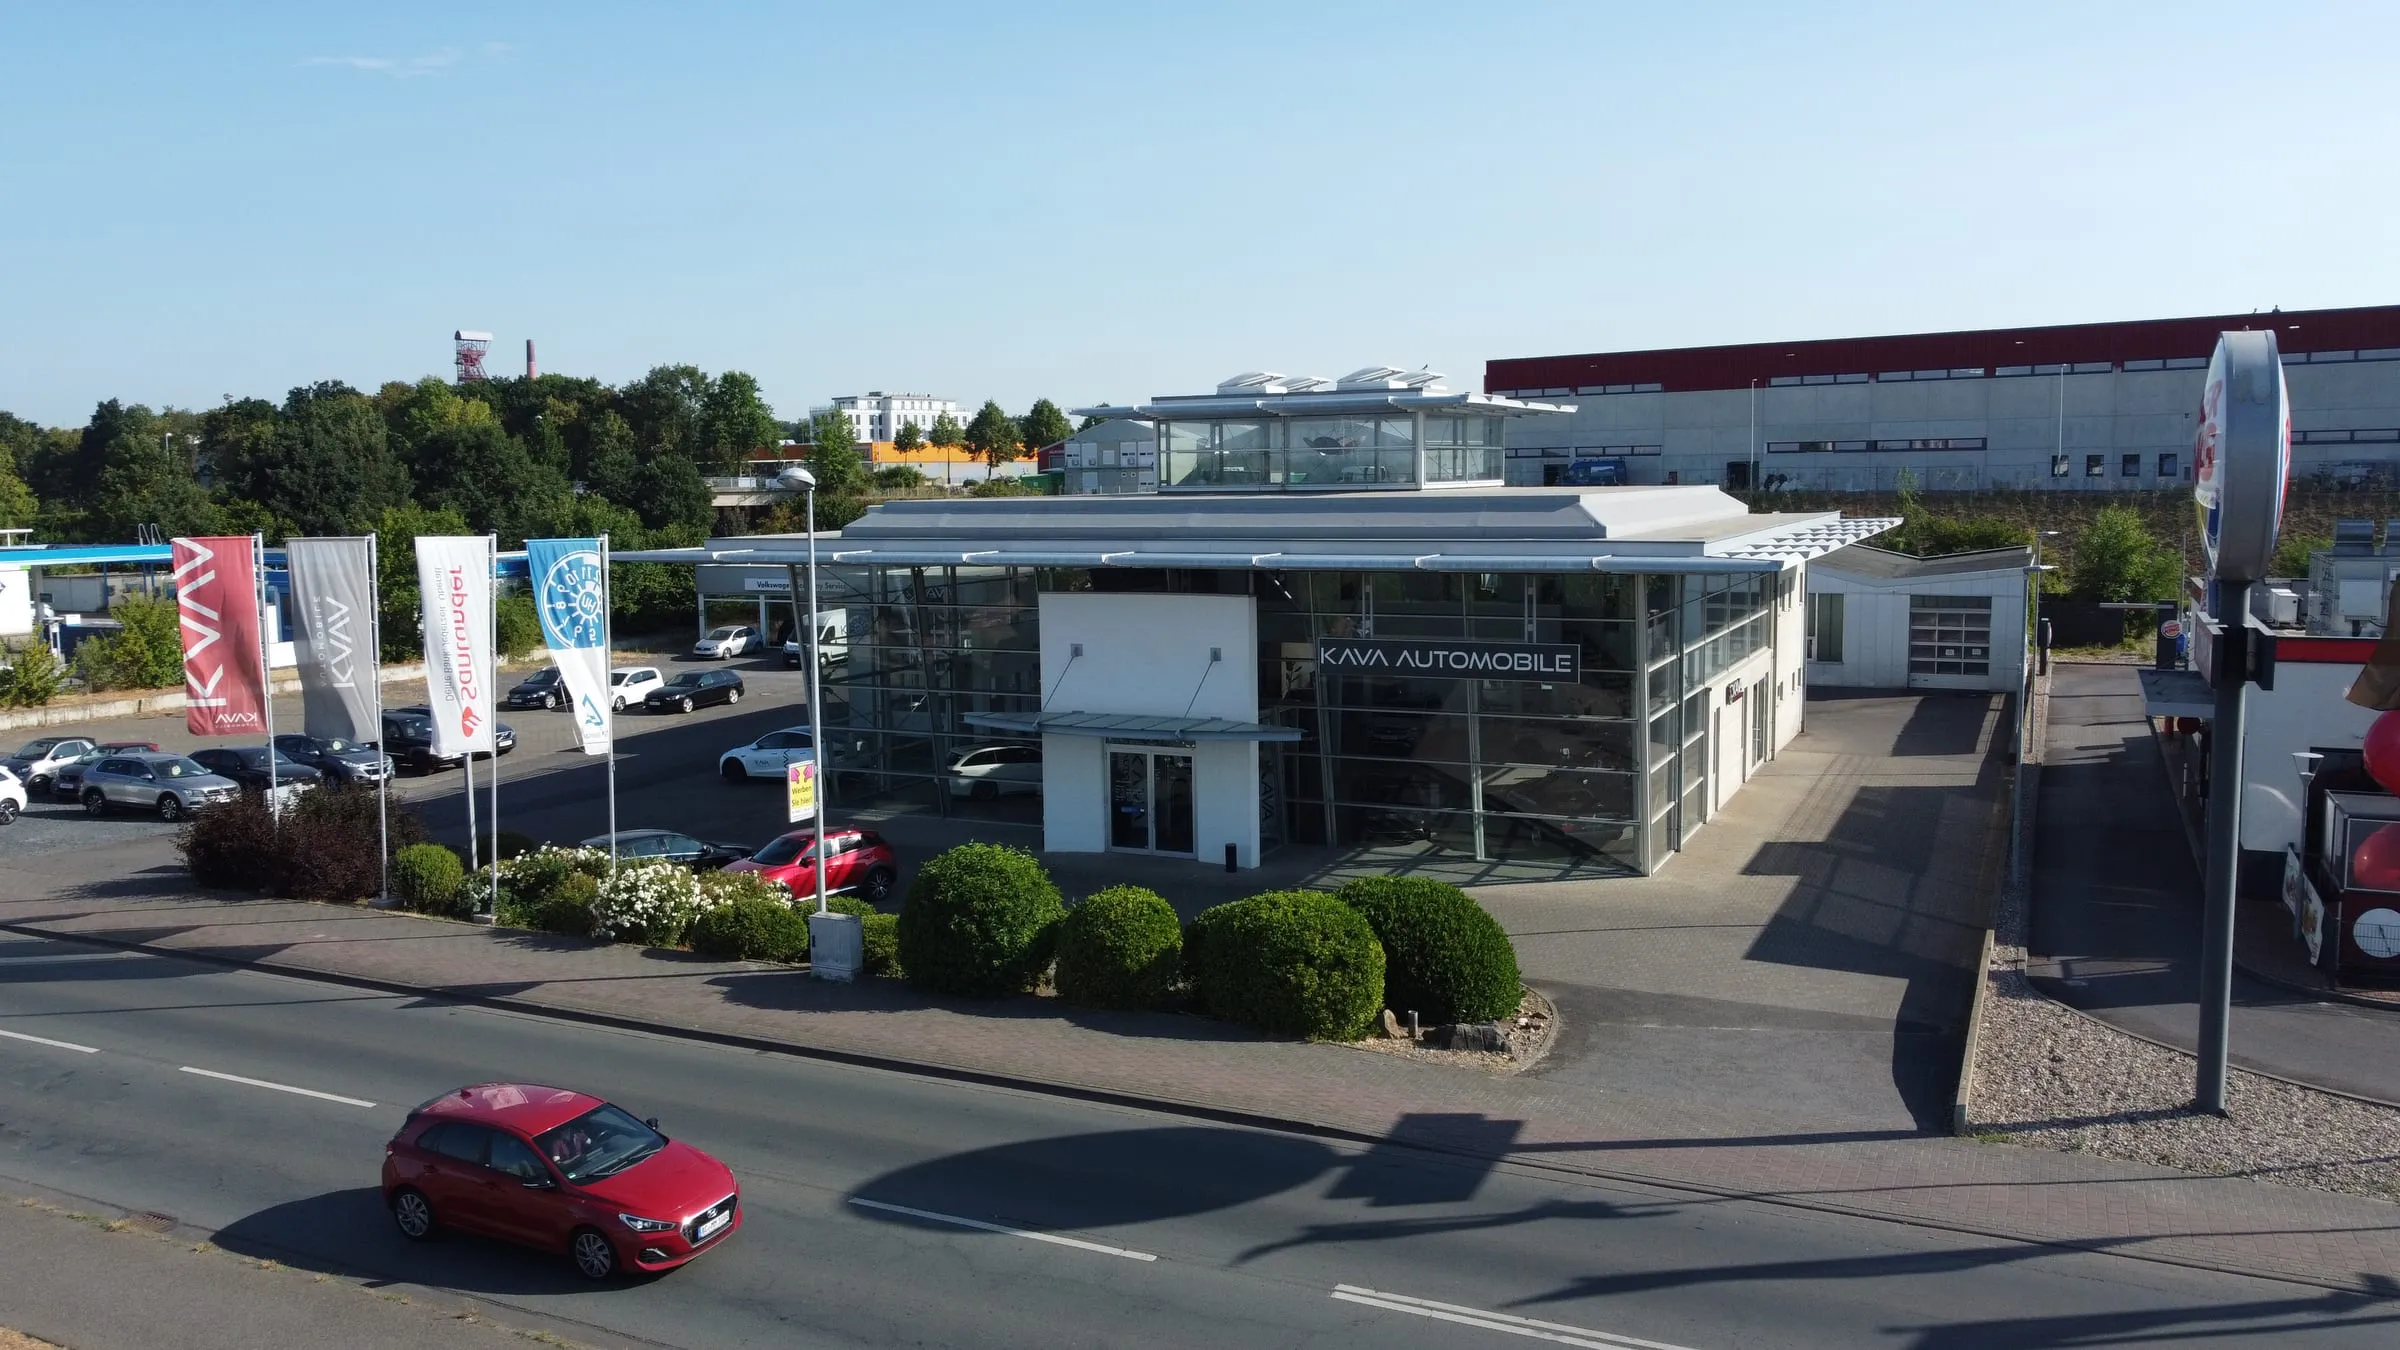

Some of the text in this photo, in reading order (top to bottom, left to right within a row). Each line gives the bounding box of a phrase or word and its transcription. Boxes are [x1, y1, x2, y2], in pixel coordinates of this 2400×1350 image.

[757, 581, 790, 590] Volkswage
[1320, 647, 1572, 673] KAVA AUTOMOBILE
